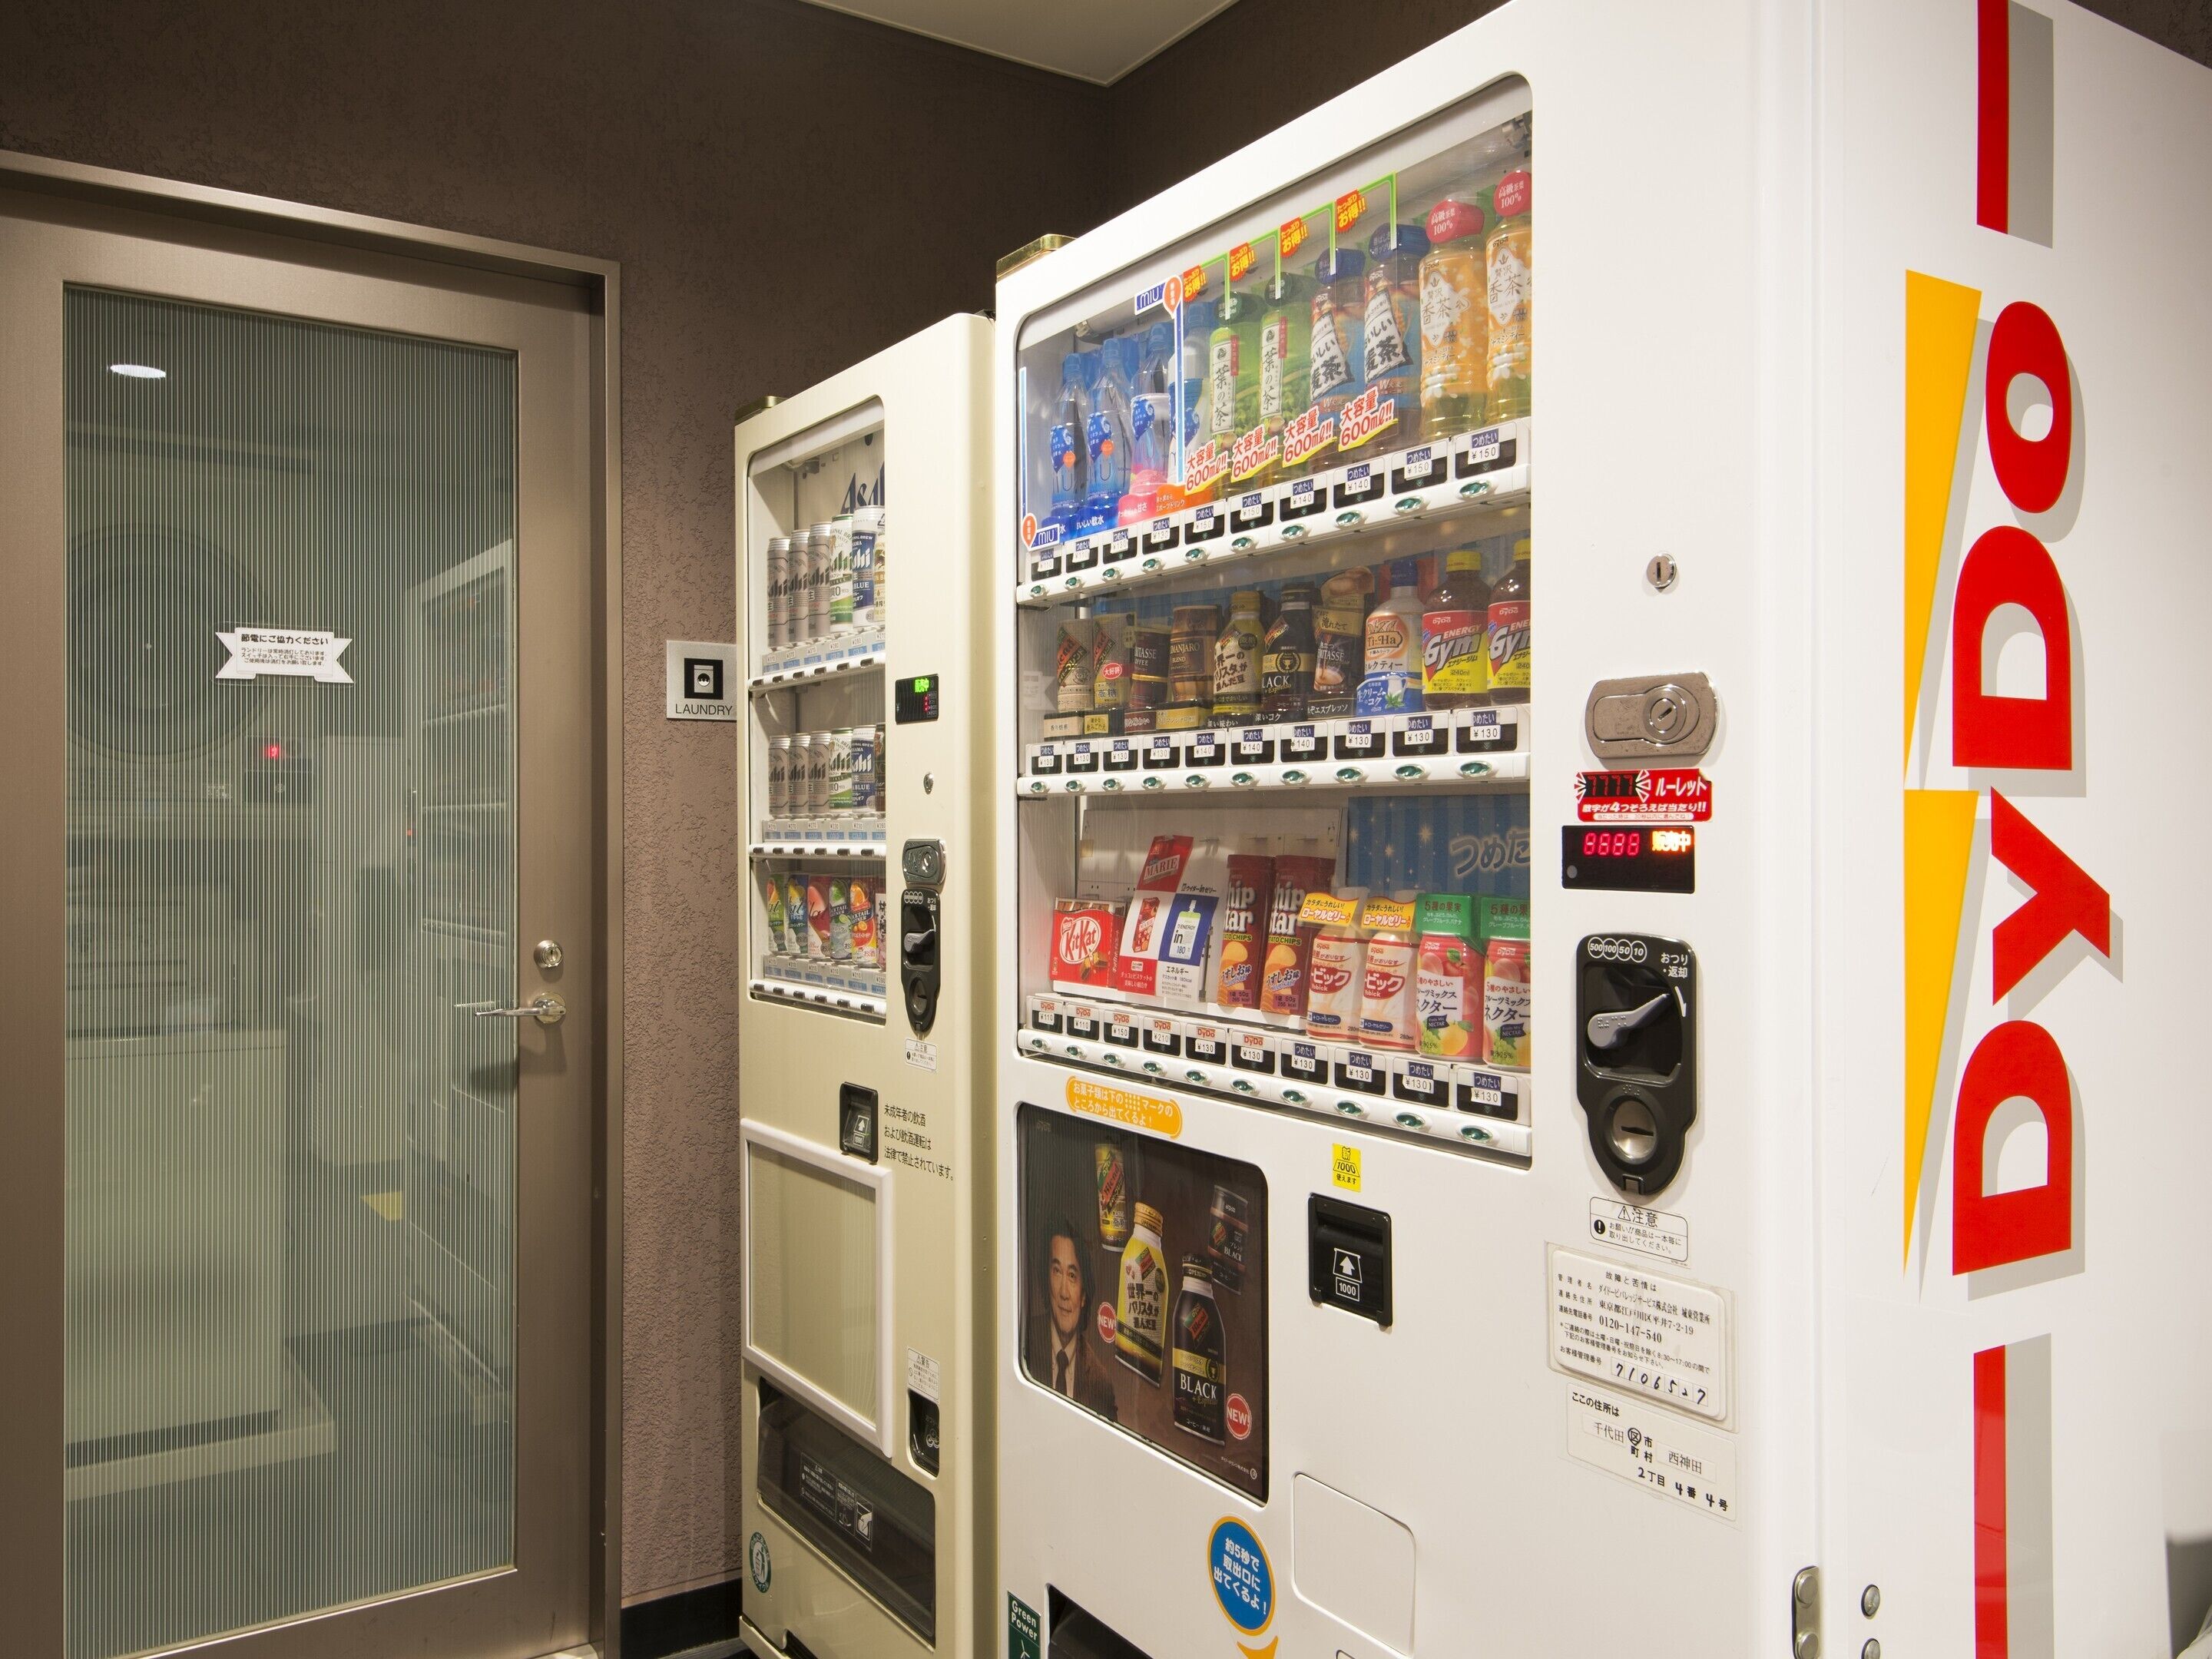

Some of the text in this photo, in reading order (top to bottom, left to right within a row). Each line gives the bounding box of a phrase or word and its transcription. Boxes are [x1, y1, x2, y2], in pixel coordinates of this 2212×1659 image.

[1501, 193, 1522, 208] 100%
[1433, 220, 1453, 236] 100%
[1366, 336, 1399, 372] 麦茶
[1263, 347, 1278, 411] 葉の茶
[1214, 365, 1229, 427] 葉の茶
[1343, 390, 1377, 423] 大容量
[1286, 409, 1317, 442] 大容量
[1234, 427, 1263, 459] 大容量
[1472, 432, 1498, 448] つめたい
[1187, 442, 1214, 472] 大容量
[1407, 449, 1431, 464] つめたい
[1471, 447, 1496, 460] ¥150
[1348, 465, 1369, 479] つめたい
[1407, 462, 1429, 475] ¥150
[1293, 480, 1313, 494] つめたい
[1347, 479, 1369, 492] ¥140
[1243, 494, 1261, 507] つめたい
[1292, 494, 1312, 505] ¥140
[1443, 624, 1482, 639] ENERGY
[241, 634, 329, 645] 節電にご協力ください
[1425, 634, 1480, 671] Gym
[1447, 656, 1478, 668] エナジージム
[675, 704, 733, 715] LAUNDRY
[1197, 733, 1214, 744] つめたい
[1244, 730, 1262, 741] つめたい
[1408, 732, 1429, 742] ¥130
[1474, 727, 1498, 738] ¥130
[1154, 737, 1170, 747] つめたい
[1243, 742, 1260, 752] ¥140
[1348, 736, 1369, 746] ¥130
[1113, 751, 1128, 760] ¥130
[1195, 747, 1212, 756] ¥140
[1656, 777, 1707, 796] ルーレット
[1582, 802, 1707, 813] 数字が4つそろえば当たり!!
[1584, 833, 1640, 856] 8888
[1144, 858, 1178, 878] MARIE
[1229, 881, 1255, 909] hip
[1277, 882, 1305, 912] hip
[1306, 899, 1345, 909] カラダにうれしい!
[1366, 904, 1404, 912] カラダにうれしい!
[1425, 901, 1462, 912] 5種の果実
[1225, 909, 1253, 933] tar
[1302, 909, 1346, 920] ローヤルゼリー
[1363, 913, 1406, 927] ローヤルゼリー
[1270, 912, 1298, 936] tar
[1065, 921, 1097, 960] KitKat
[1174, 930, 1183, 944] in
[1177, 945, 1186, 954] 180
[1604, 945, 1617, 953] 100
[1634, 948, 1644, 956] 10
[1661, 952, 1688, 965] おつり
[1075, 1019, 1089, 1029] ¥110
[1113, 1026, 1128, 1036] ¥150
[1154, 1020, 1171, 1031] DyDo
[1197, 1028, 1216, 1038] DyDo
[1197, 1043, 1214, 1053] ¥130
[1244, 1035, 1263, 1047] DyDo
[1243, 1050, 1260, 1061] ¥130
[1295, 1044, 1315, 1057] つめたい
[1293, 1058, 1313, 1070] ¥130
[1350, 1053, 1372, 1067] つめたい
[1349, 1068, 1369, 1081] ¥130
[1409, 1063, 1433, 1077] つめたい
[1475, 1074, 1500, 1088] つめたい
[1074, 1083, 1173, 1117] お菓子類は下の マークの
[1475, 1091, 1498, 1103] ¥130
[884, 1104, 926, 1127] 未成年者の飲酒
[1075, 1098, 1153, 1127] ところから出てくるよ!
[884, 1125, 932, 1151] および飲酒運転は
[884, 1146, 953, 1181] 法律で禁止されています。
[1337, 1162, 1356, 1174] 1000
[1336, 1174, 1356, 1184] 使えます
[1631, 1207, 1658, 1228] 注意
[1608, 1223, 1681, 1246] お願い!!商品は一本毎に
[1608, 1231, 1672, 1254] 取り出してください。
[1224, 1247, 1242, 1262] BLACK
[1605, 1271, 1657, 1292] 故障と苦情は
[1127, 1283, 1159, 1302] 世界一の
[1339, 1283, 1356, 1296] 1000
[1558, 1273, 1592, 1290] 管理者名
[1682, 1306, 1710, 1325] 城東営業所
[1558, 1290, 1694, 1336] 連絡先住所 東京都江戸川区平井7-2-19
[1558, 1306, 1662, 1344] 連絡先電話番号 0120-147-540
[1560, 1346, 1602, 1366] お客様管理番号
[1565, 1330, 1664, 1369] 下記のお客様管理番号をお知らせ下さい。
[1181, 1373, 1217, 1399] BLACK
[1571, 1392, 1620, 1417] ここの住所は
[1227, 1406, 1251, 1426] NEW!
[1594, 1421, 1625, 1445] 千代田
[1668, 1450, 1703, 1475] 西神田
[1637, 1467, 1728, 1512] 2丁目 4番 4号
[1225, 1538, 1260, 1571] 約5秒で
[1224, 1554, 1260, 1591] 取出口に
[1214, 1566, 1267, 1614] 出てくるよ!
[1012, 1599, 1037, 1628] Green
[1011, 1614, 1038, 1641] Power
